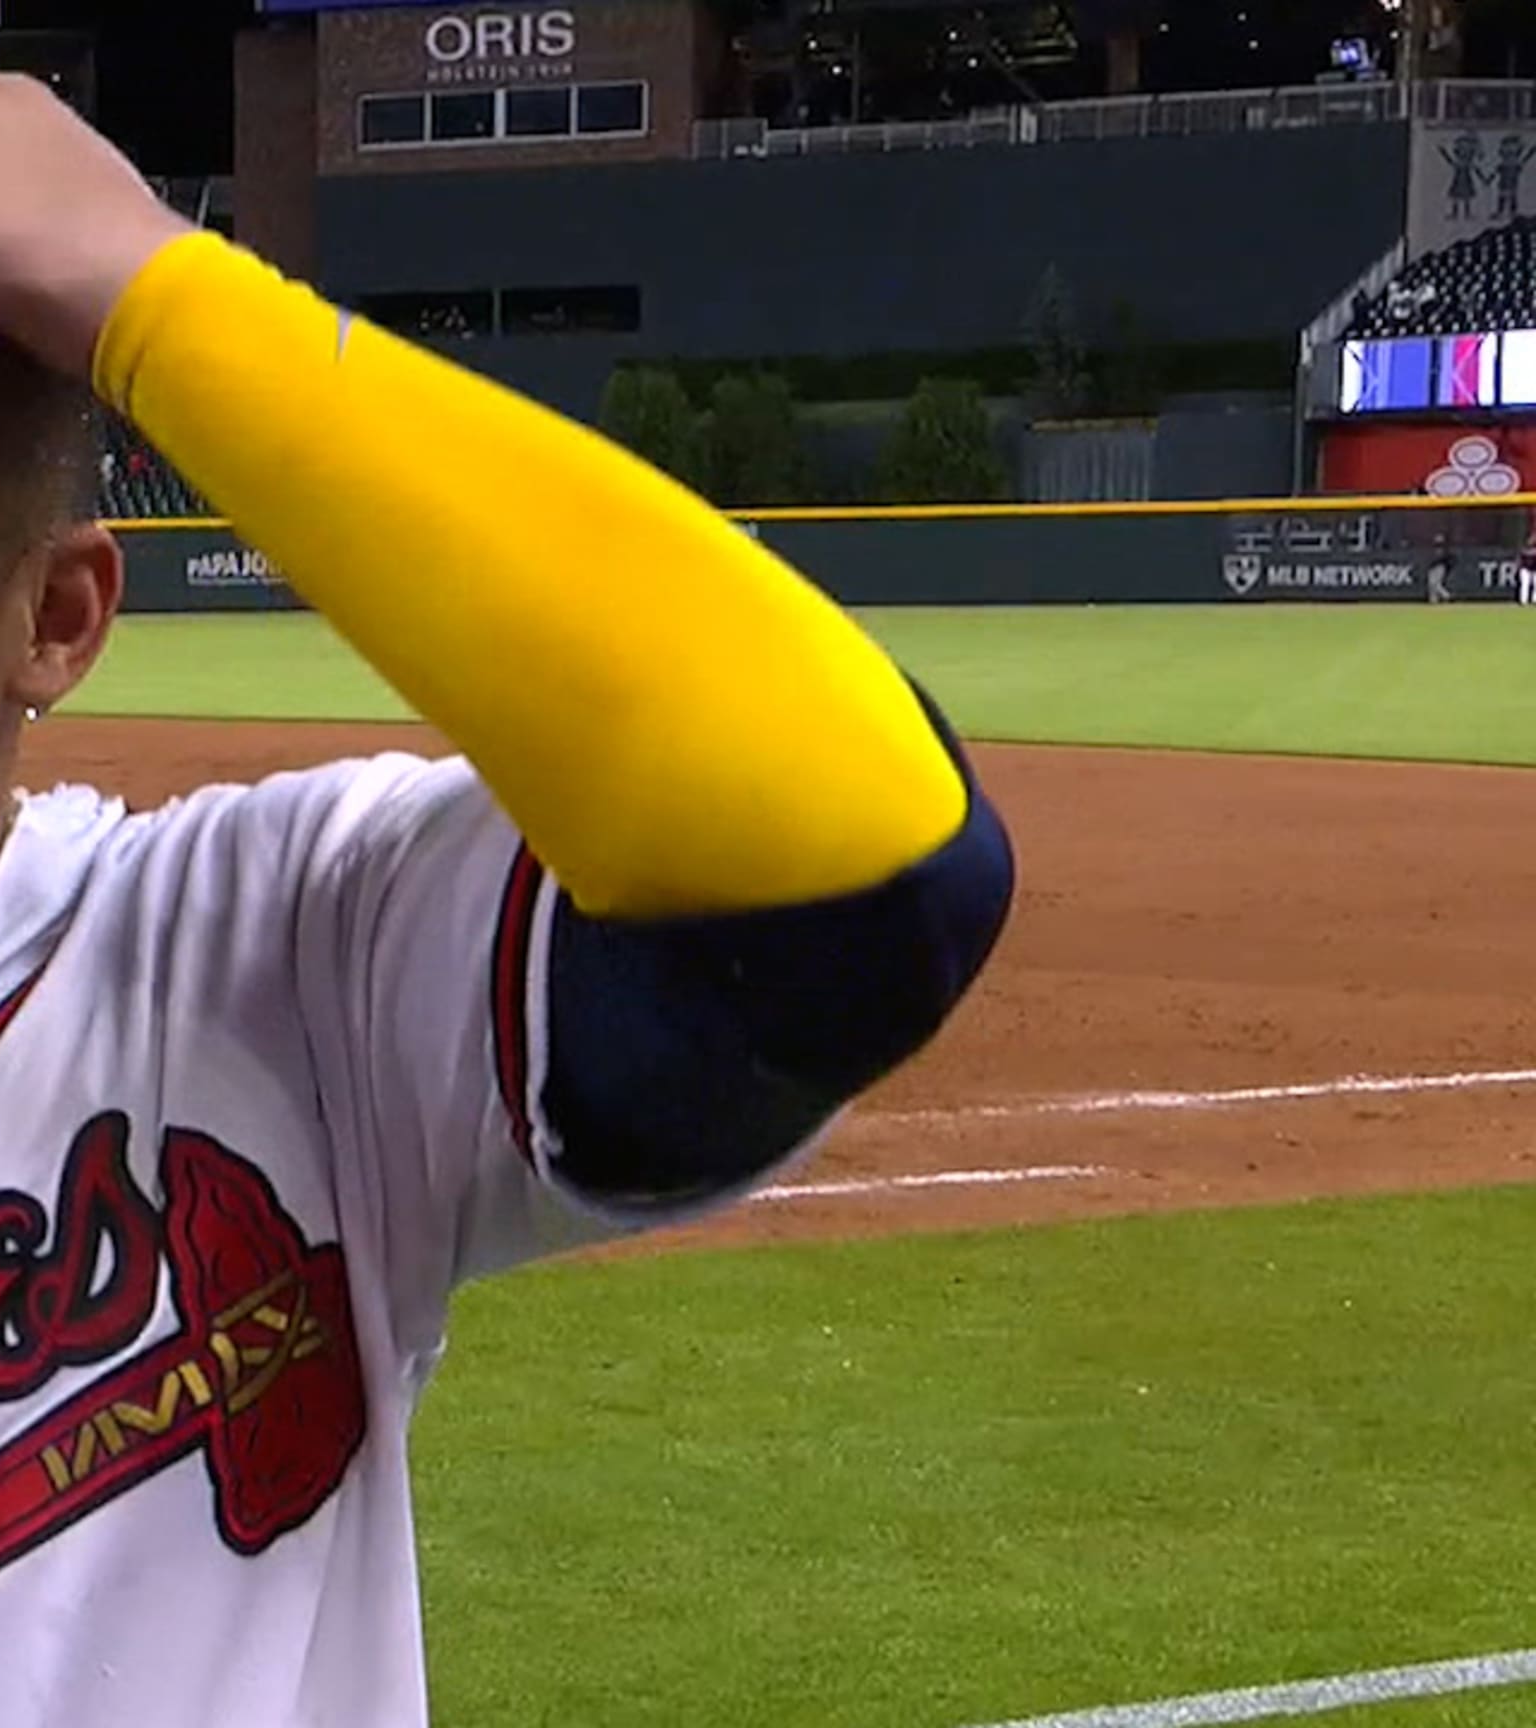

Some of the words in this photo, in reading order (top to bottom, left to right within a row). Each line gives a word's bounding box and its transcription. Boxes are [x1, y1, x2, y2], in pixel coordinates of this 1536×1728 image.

[426, 10, 575, 61] ORIS
[187, 552, 239, 577] PAPA
[1267, 563, 1311, 586] MLB
[1314, 562, 1412, 586] NETWORK
